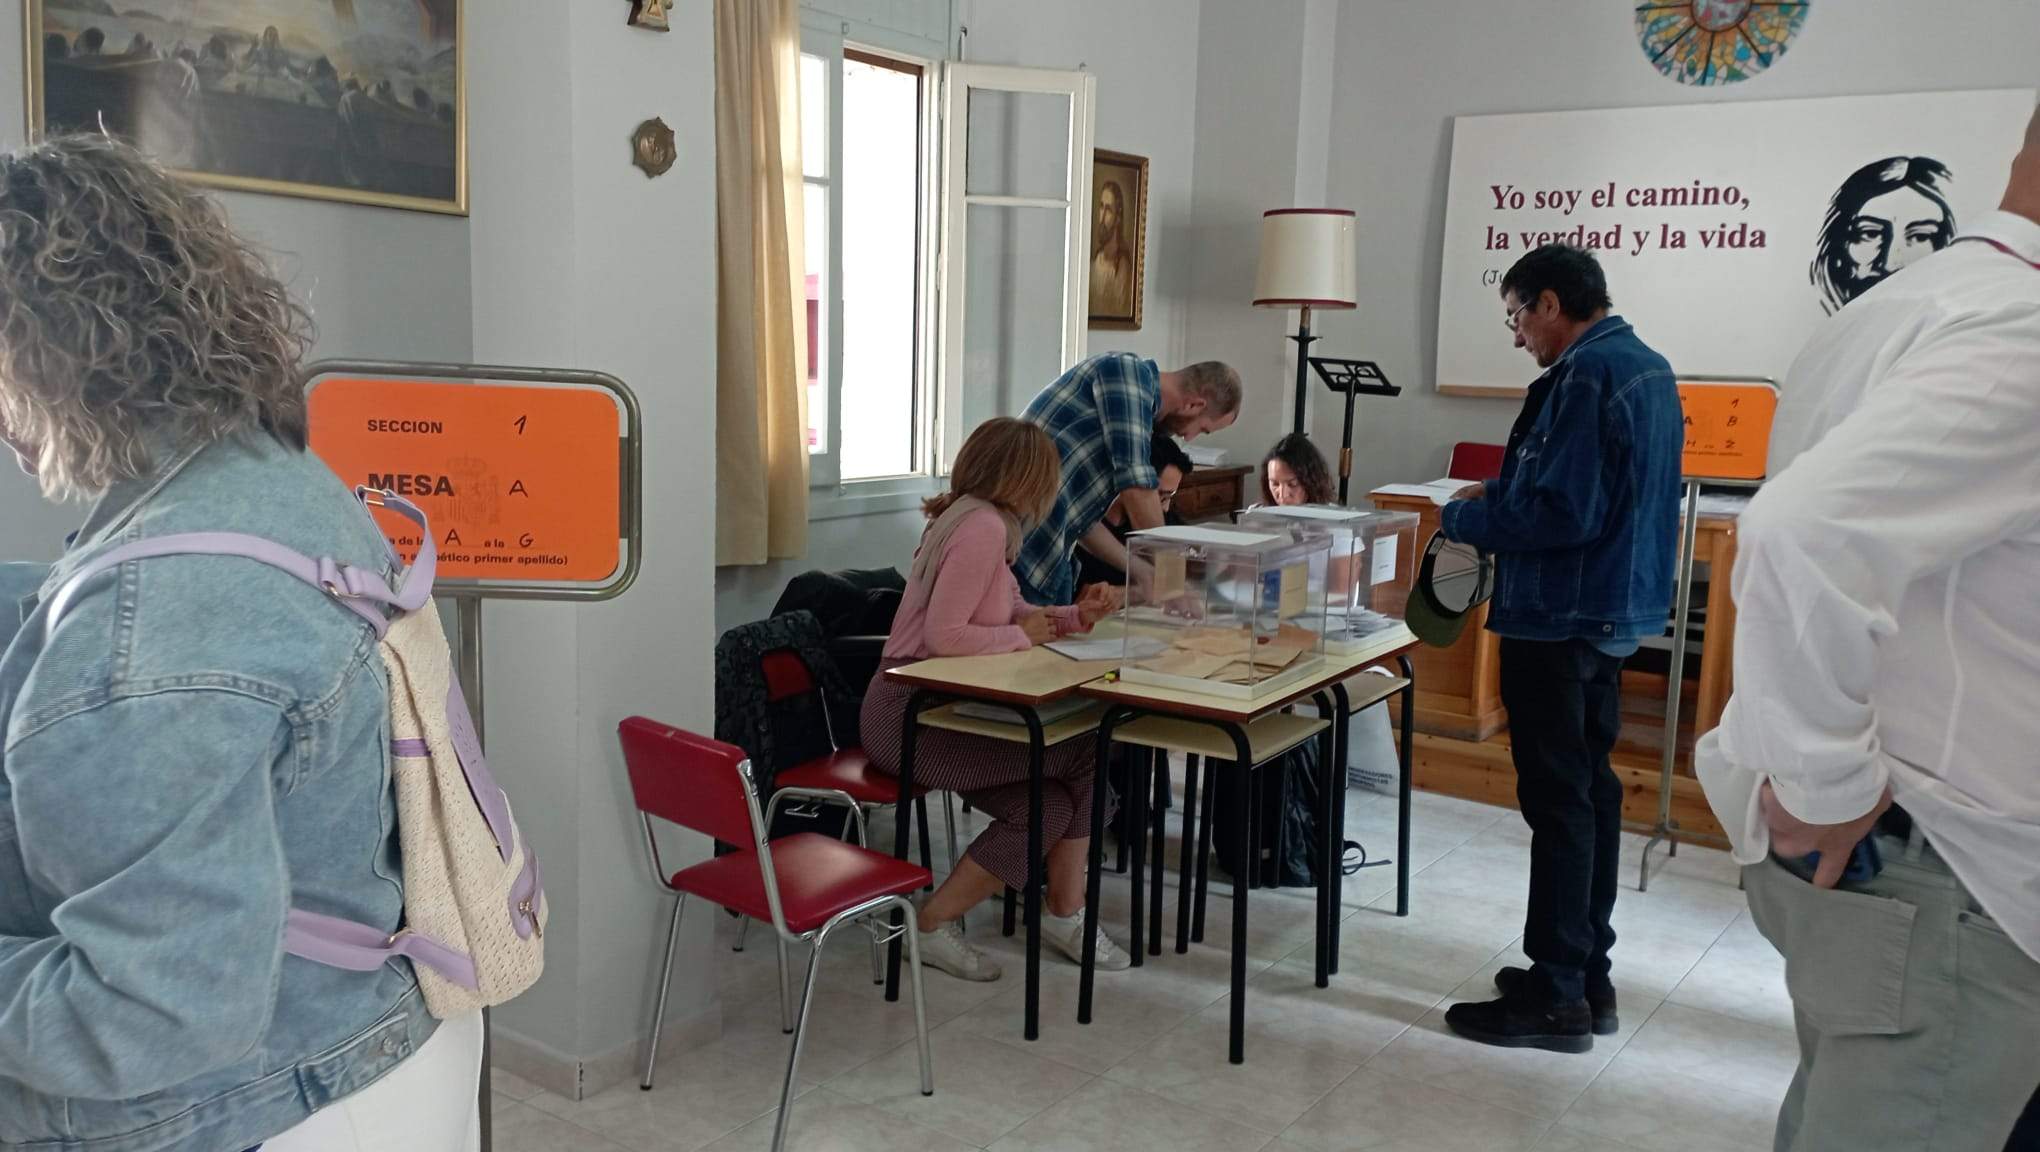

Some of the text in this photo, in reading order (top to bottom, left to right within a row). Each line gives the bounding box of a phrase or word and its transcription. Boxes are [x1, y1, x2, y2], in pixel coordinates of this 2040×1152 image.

[1490, 180, 1750, 215] Yo soy el camino,
[1485, 222, 1767, 256] la verdad y la vida
[367, 415, 527, 435] SECCION 1
[368, 473, 529, 498] MESA A
[398, 536, 413, 545] de
[444, 528, 462, 547] A
[494, 538, 505, 549] la
[519, 532, 535, 549] G
[474, 554, 513, 564] primer
[517, 555, 568, 566] apellido)
